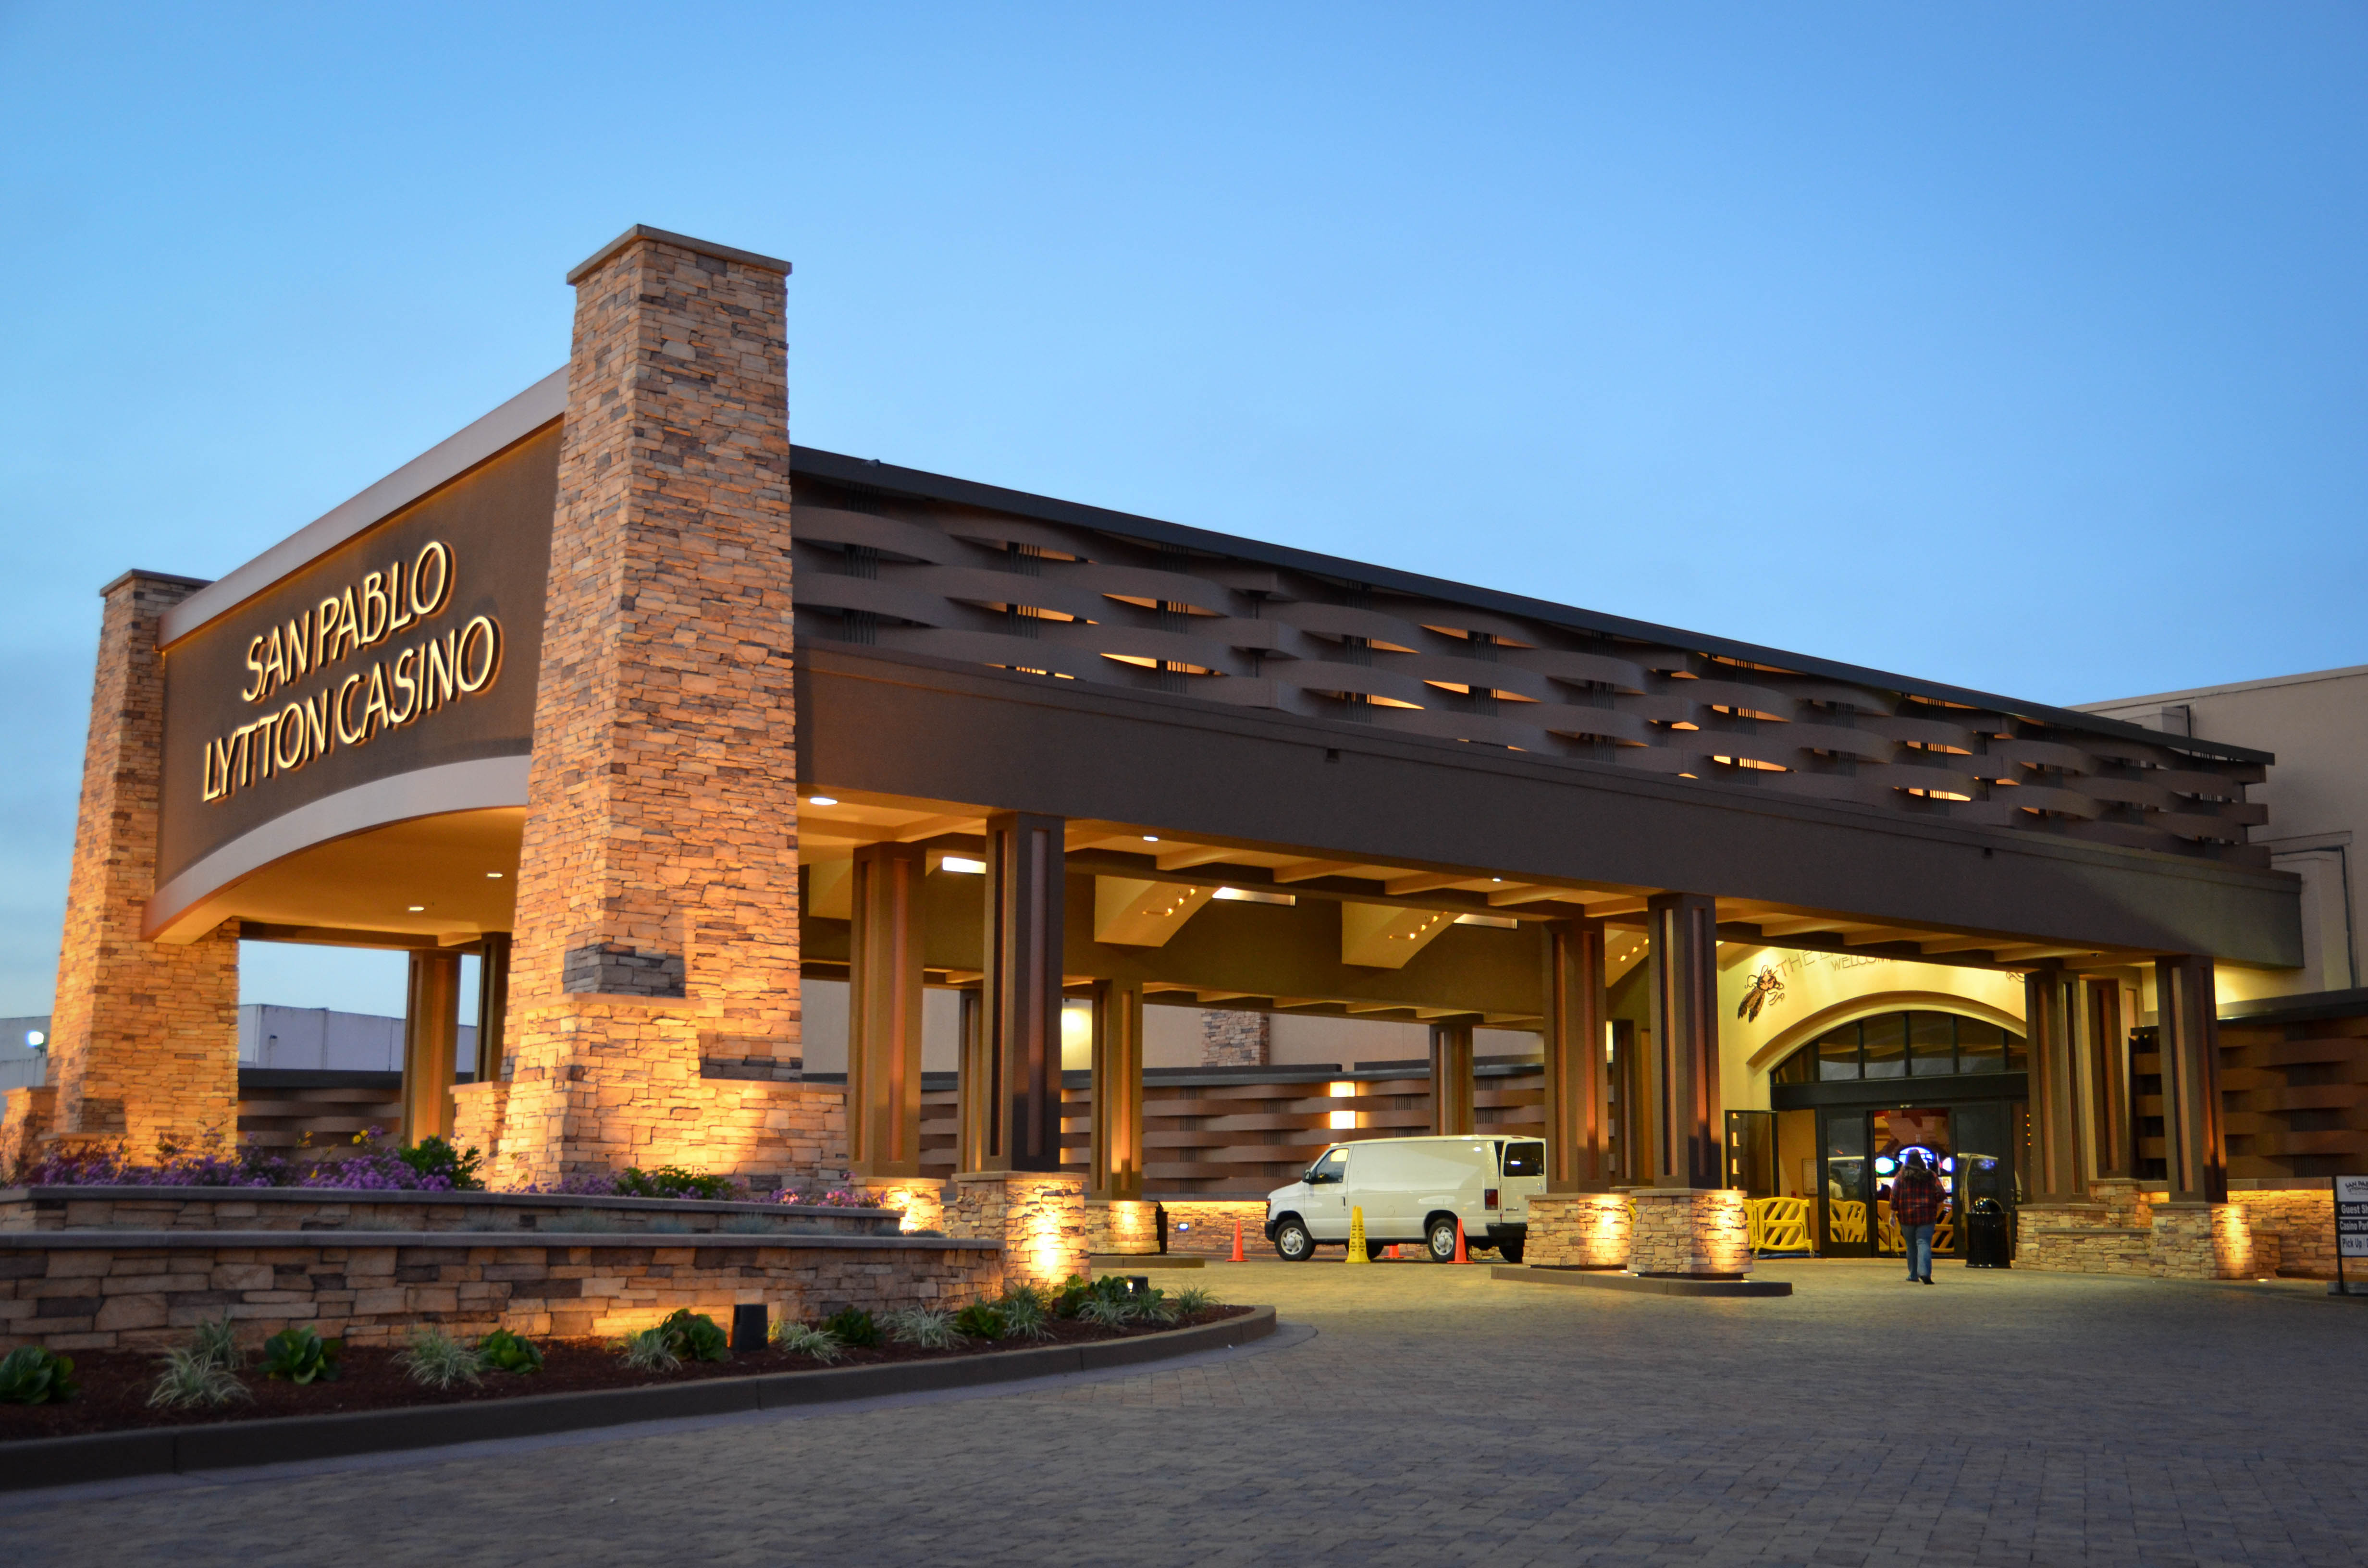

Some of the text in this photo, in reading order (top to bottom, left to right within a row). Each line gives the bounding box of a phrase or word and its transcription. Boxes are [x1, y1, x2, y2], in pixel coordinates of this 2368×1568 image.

[242, 541, 447, 702] SAN PABLO
[203, 616, 495, 802] LYTTON CASINO
[1776, 950, 1815, 977] THE
[2341, 1204, 2360, 1214] Guest
[2340, 1221, 2357, 1230] Casino
[2342, 1237, 2354, 1248] Pick
[2355, 1237, 2362, 1250] Up
